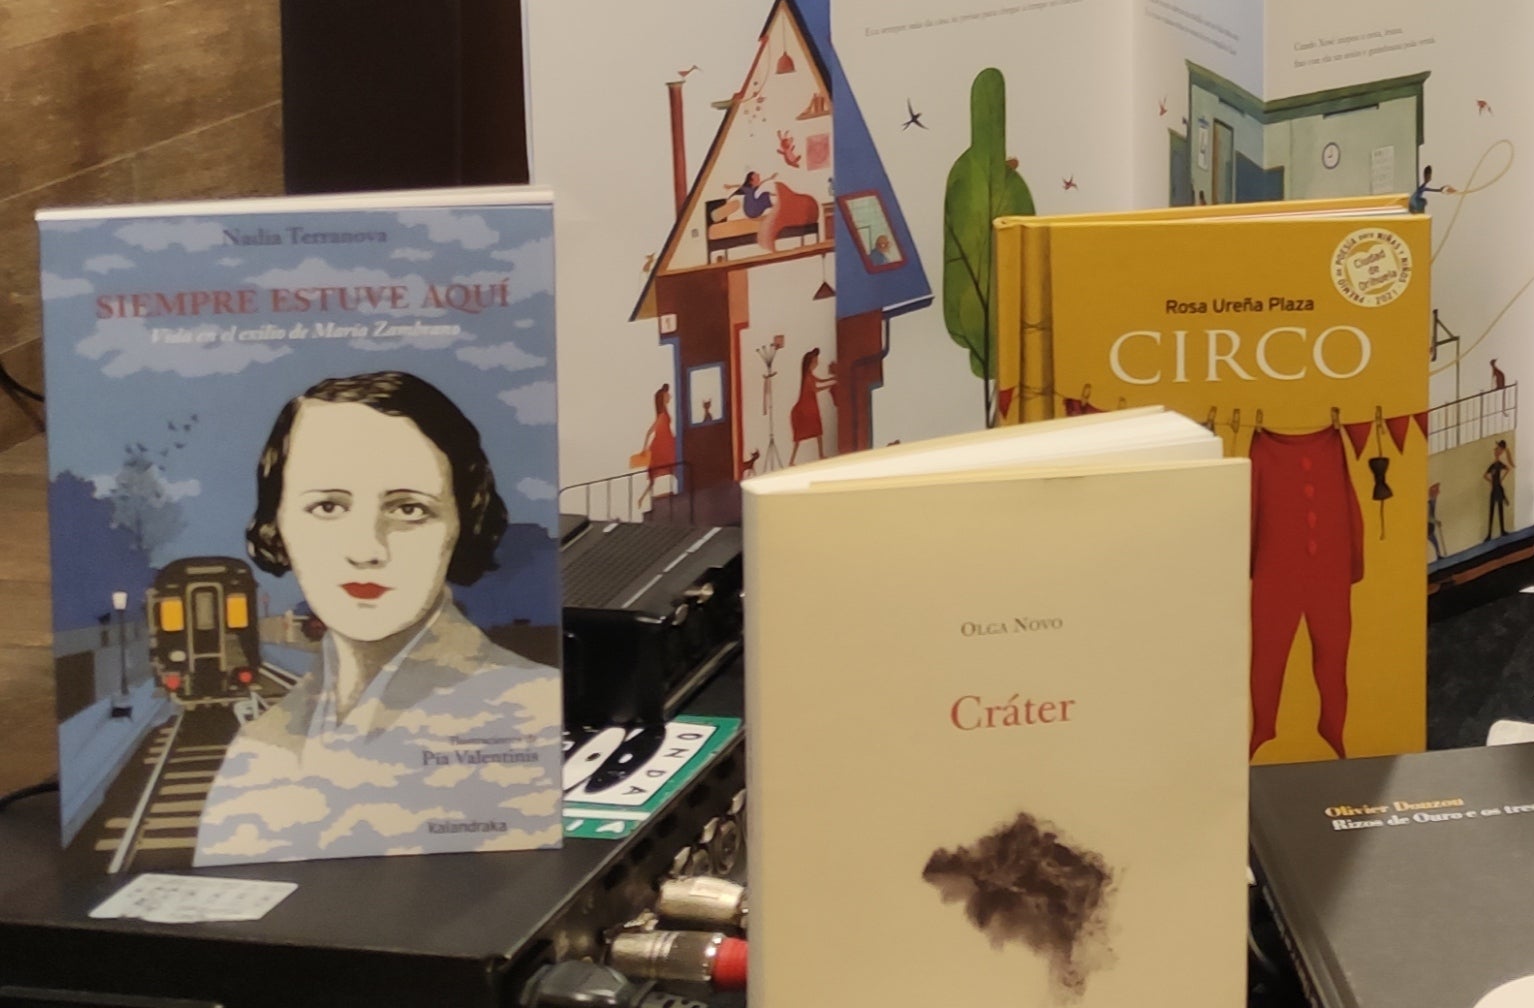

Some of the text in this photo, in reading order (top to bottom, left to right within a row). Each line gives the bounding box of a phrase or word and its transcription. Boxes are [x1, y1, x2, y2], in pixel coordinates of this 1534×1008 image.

[95, 277, 511, 320] SIEMPRE ESTUVE AQUÍ
[1165, 297, 1315, 315] Rosa Ureña Plaza
[1109, 325, 1372, 385] CIRCO
[951, 693, 1076, 731] Cráter
[1324, 803, 1390, 818] Olivier
[1332, 817, 1384, 831] Rizos
[1387, 814, 1411, 826] de
[1412, 811, 1463, 824] Ouro
[1466, 809, 1478, 818] e
[1480, 807, 1502, 817] os
